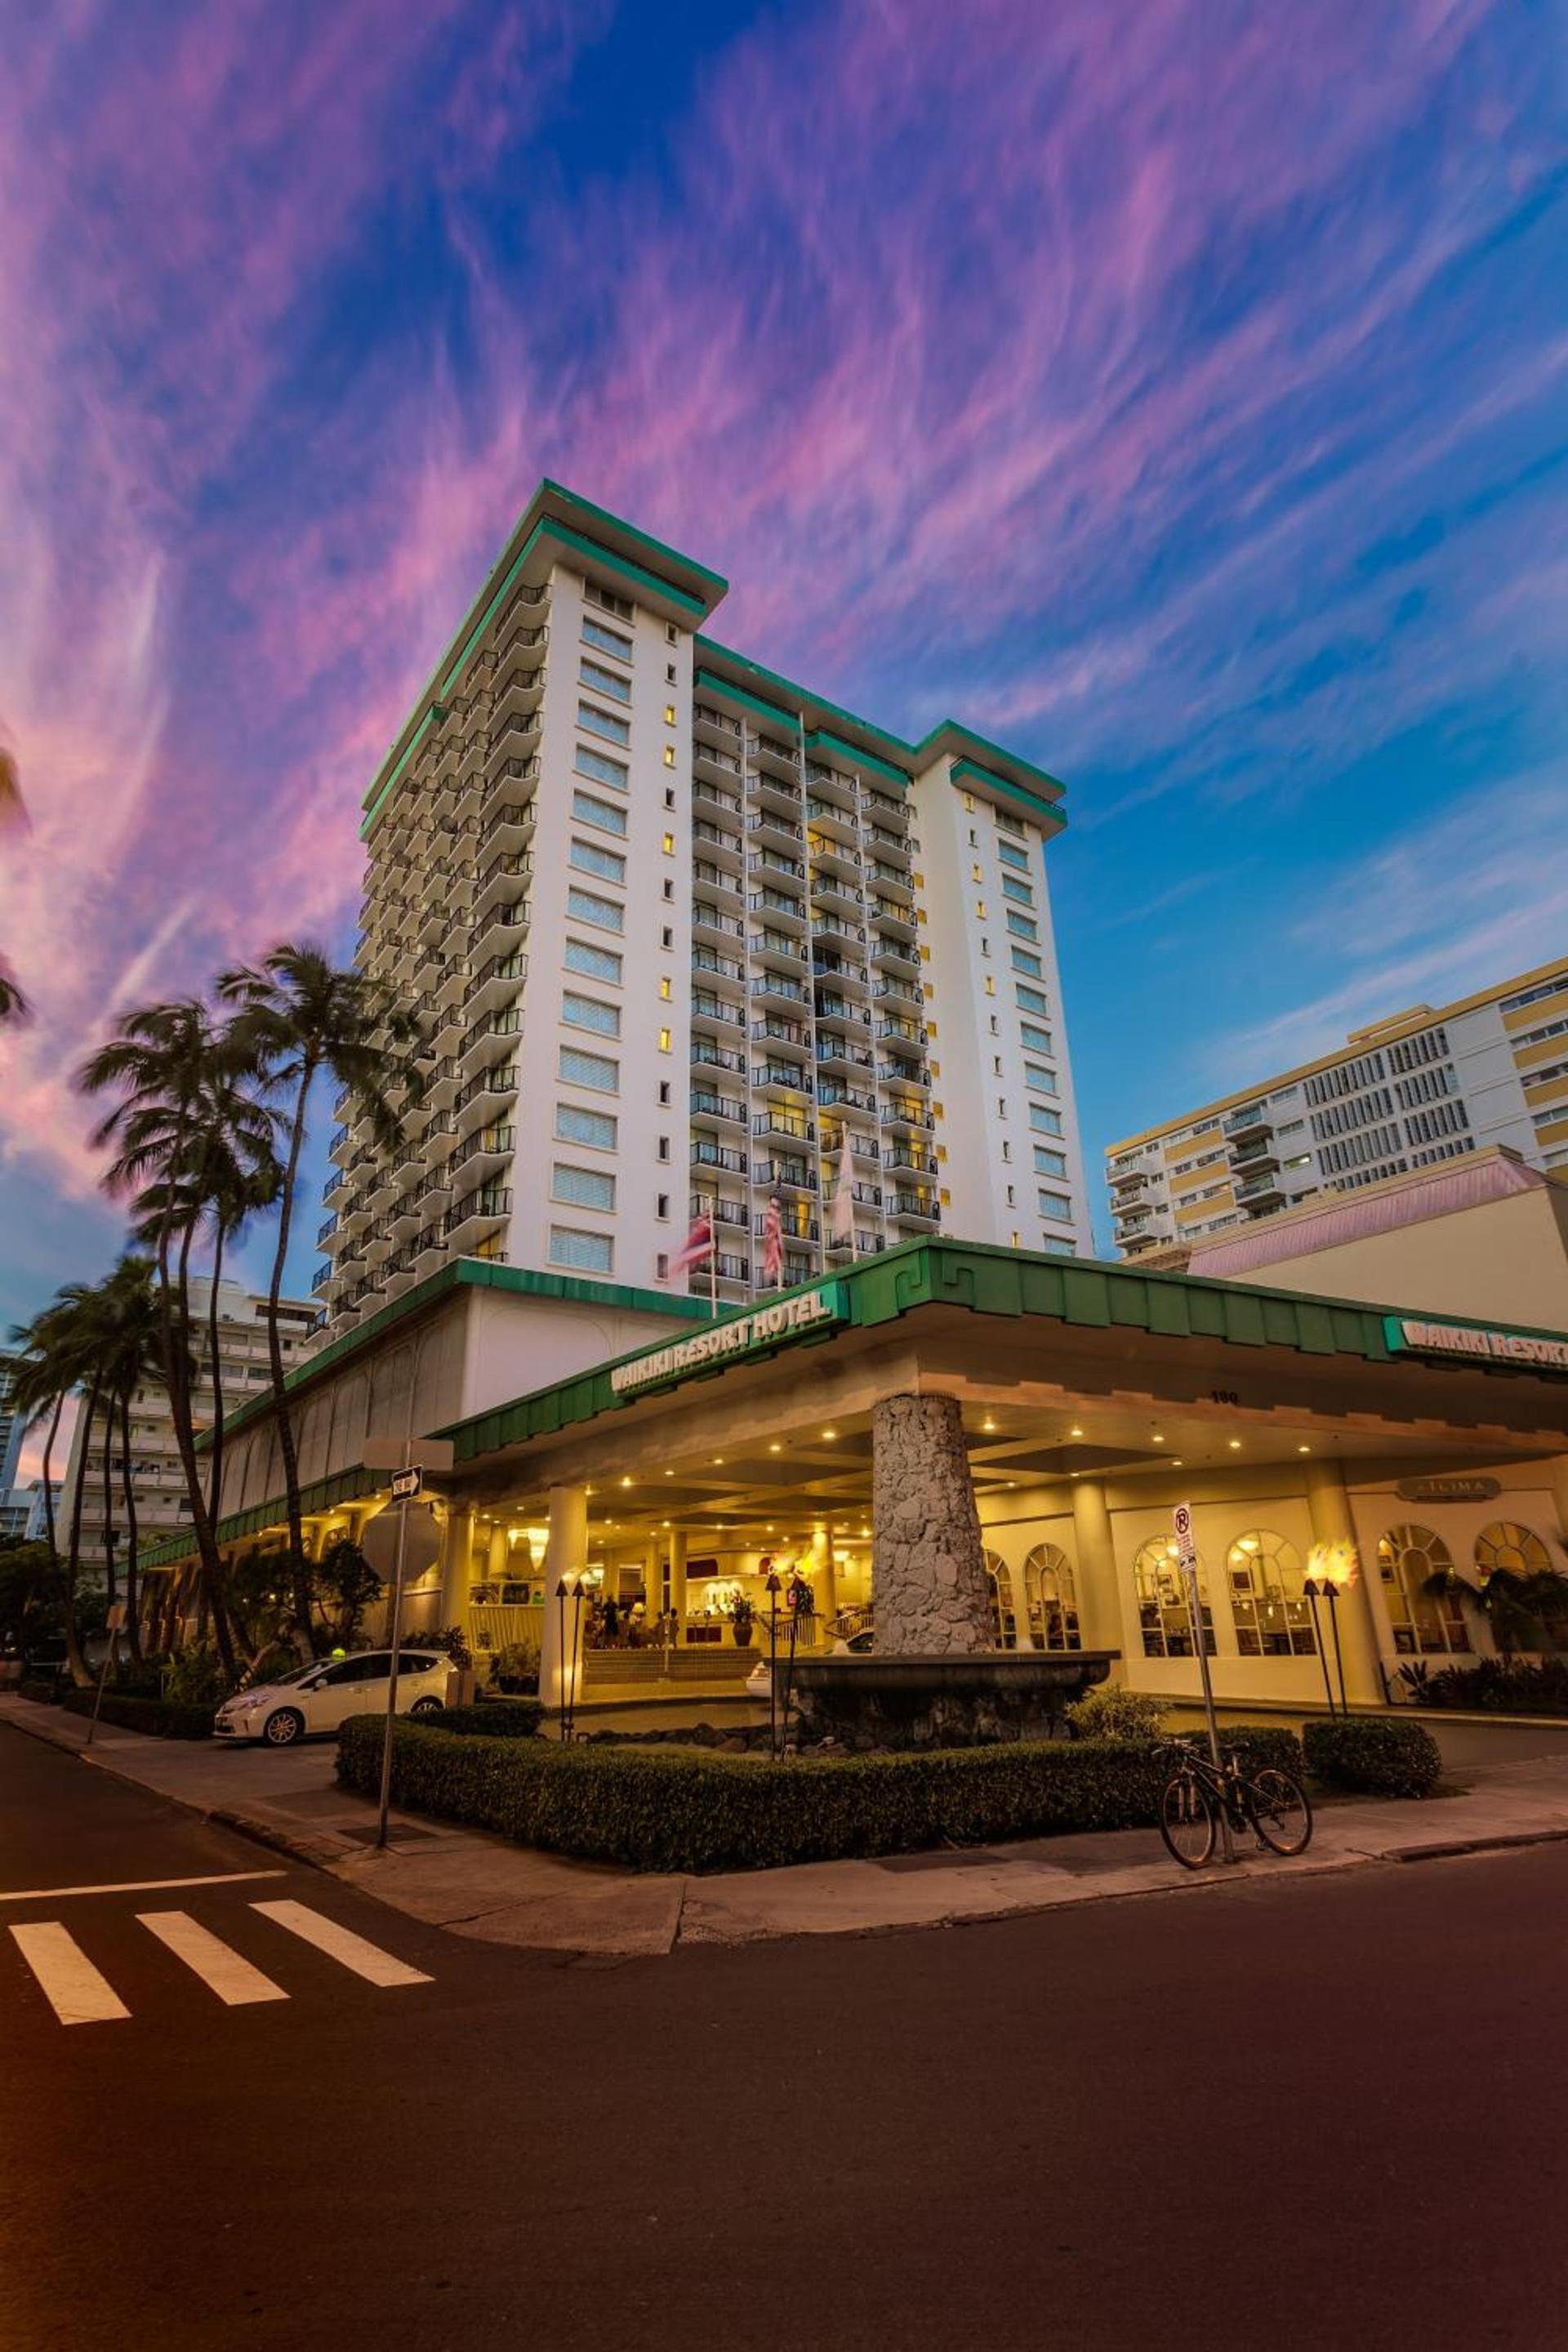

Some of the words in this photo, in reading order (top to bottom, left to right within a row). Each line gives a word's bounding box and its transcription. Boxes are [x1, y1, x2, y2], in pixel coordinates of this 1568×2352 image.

[611, 1348, 674, 1392] WAIKIKI
[674, 1319, 751, 1369] RESORT
[753, 1291, 831, 1339] HOTEL
[1401, 1321, 1490, 1354] WAIKIKI
